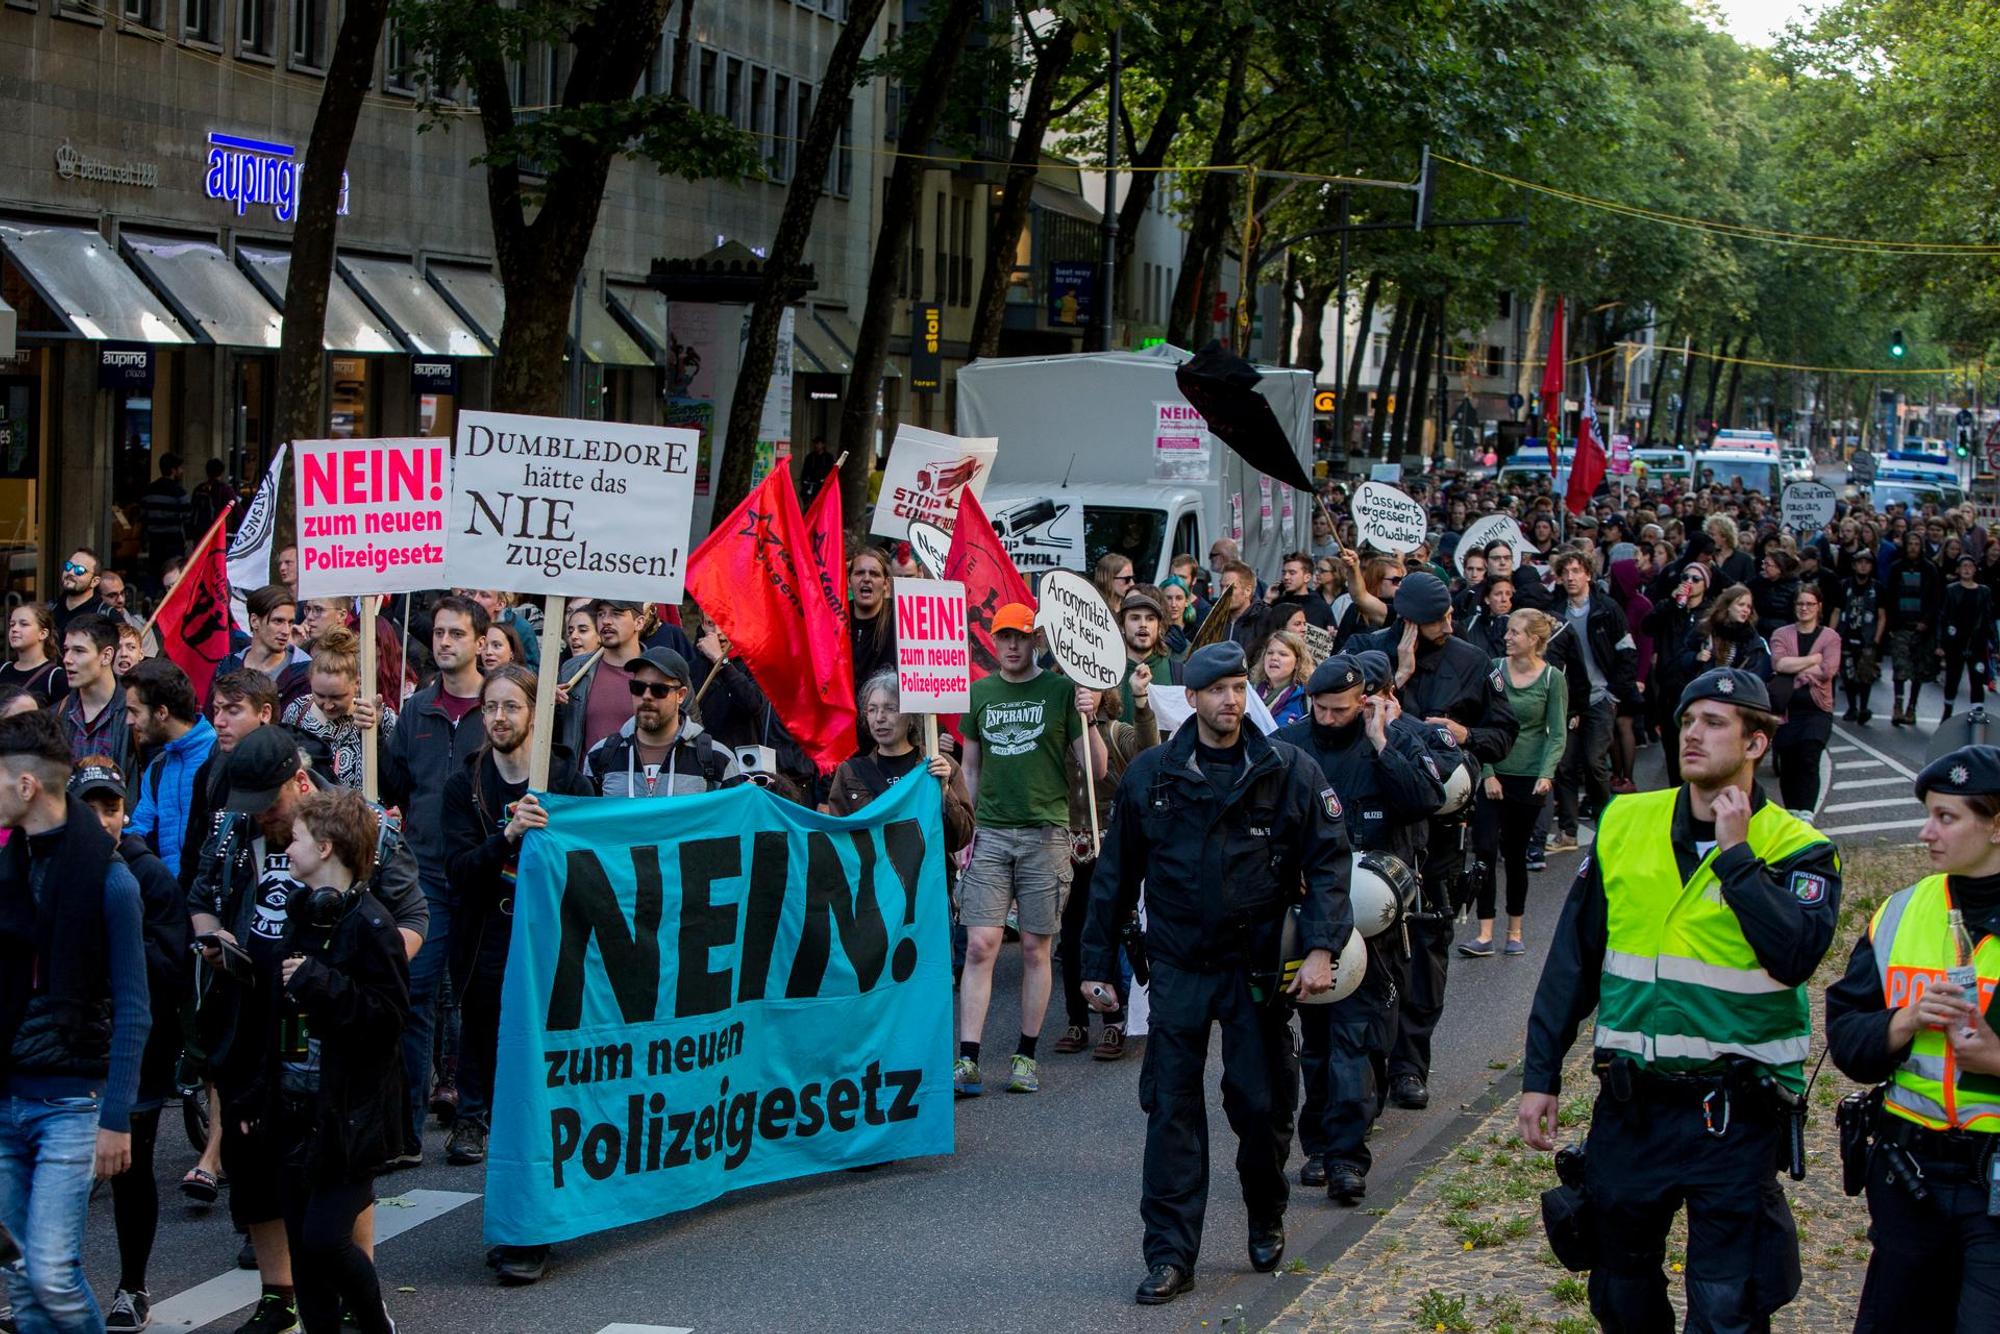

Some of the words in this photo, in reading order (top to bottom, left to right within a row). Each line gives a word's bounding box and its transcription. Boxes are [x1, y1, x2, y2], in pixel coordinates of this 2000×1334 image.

[206, 148, 294, 222] auping
[926, 309, 939, 353] stoll
[102, 352, 147, 368] auping
[414, 364, 451, 378] auping
[464, 424, 689, 475] DUMBLEDORE
[303, 448, 443, 507] NEIN!
[523, 463, 584, 490] hätte
[590, 468, 628, 494] das
[464, 490, 575, 542] NIE
[893, 487, 941, 510] STOP
[1364, 487, 1418, 514] Passwort
[304, 513, 357, 537] zum
[364, 510, 443, 533] neuen
[1356, 505, 1423, 533] vergessen?
[1364, 522, 1385, 537] 110
[1385, 527, 1423, 545] wählen
[304, 543, 444, 574] Polizeigesetz
[506, 540, 679, 578] zugelassen!
[897, 595, 965, 641] NEIN!
[1047, 575, 1110, 632] Anonymität
[1063, 612, 1077, 634] ist
[1080, 619, 1104, 650] kein
[900, 648, 925, 666] zum
[928, 648, 966, 666] neuen
[1051, 622, 1118, 685] Verbrechen
[901, 673, 967, 698] Polizeigesetz
[985, 705, 1044, 729] ESPERANTO
[546, 817, 926, 1032] NEIN!
[545, 1042, 633, 1088] zum
[647, 1021, 744, 1077] neuen
[551, 1058, 923, 1189] Polizeigesetz
